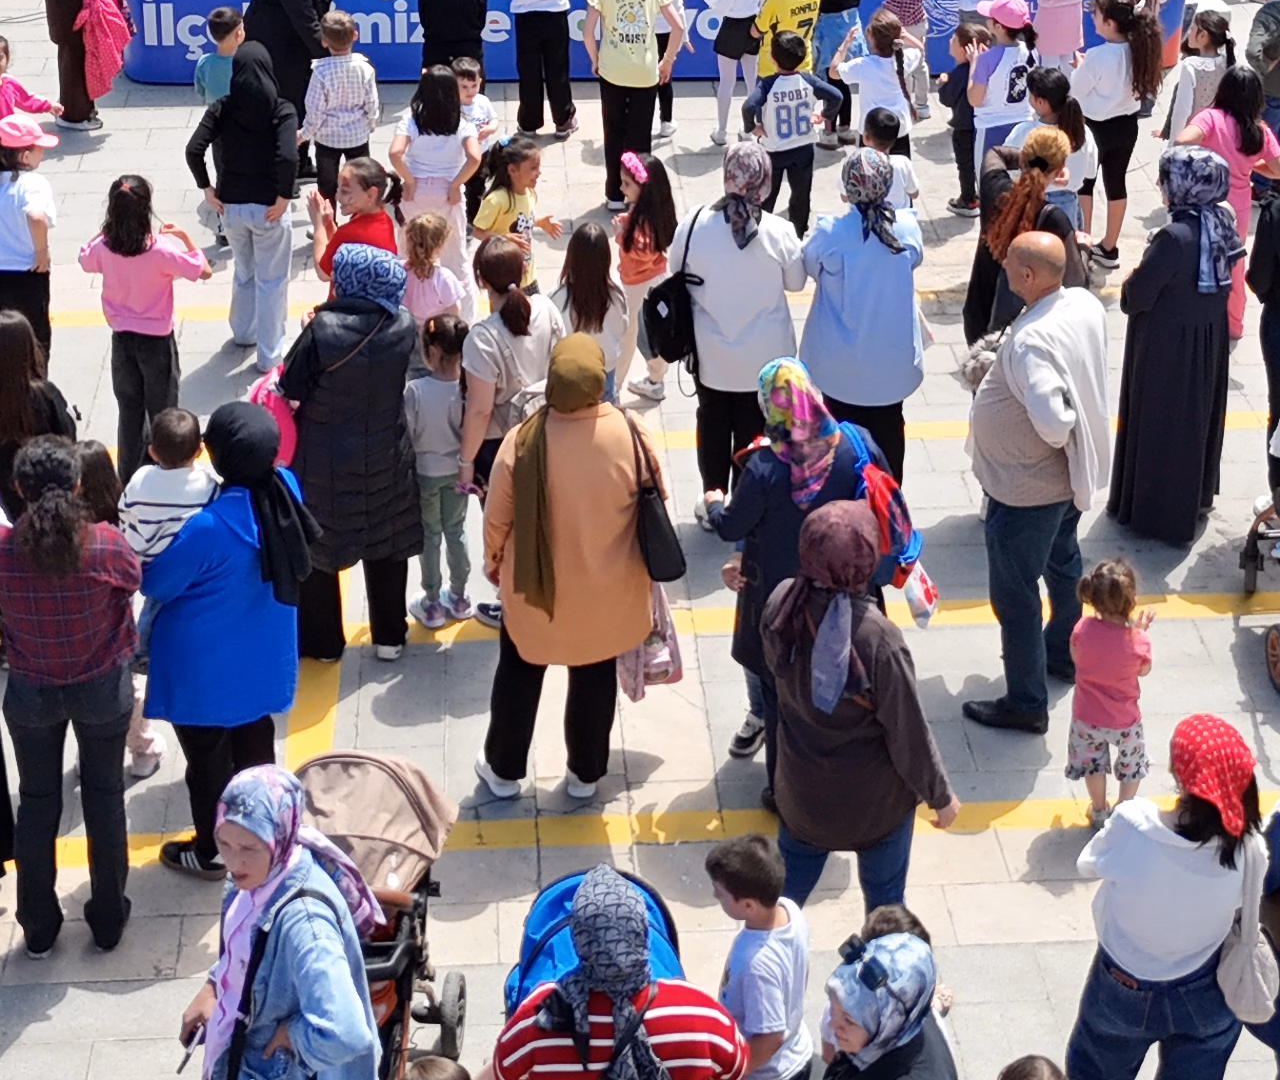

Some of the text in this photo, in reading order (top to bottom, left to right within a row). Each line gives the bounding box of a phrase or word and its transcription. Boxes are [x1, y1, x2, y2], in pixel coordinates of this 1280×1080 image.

[797, 18, 814, 39] 7
[618, 32, 648, 44] DAISY
[772, 87, 811, 103] SPORT
[775, 102, 813, 140] 86
